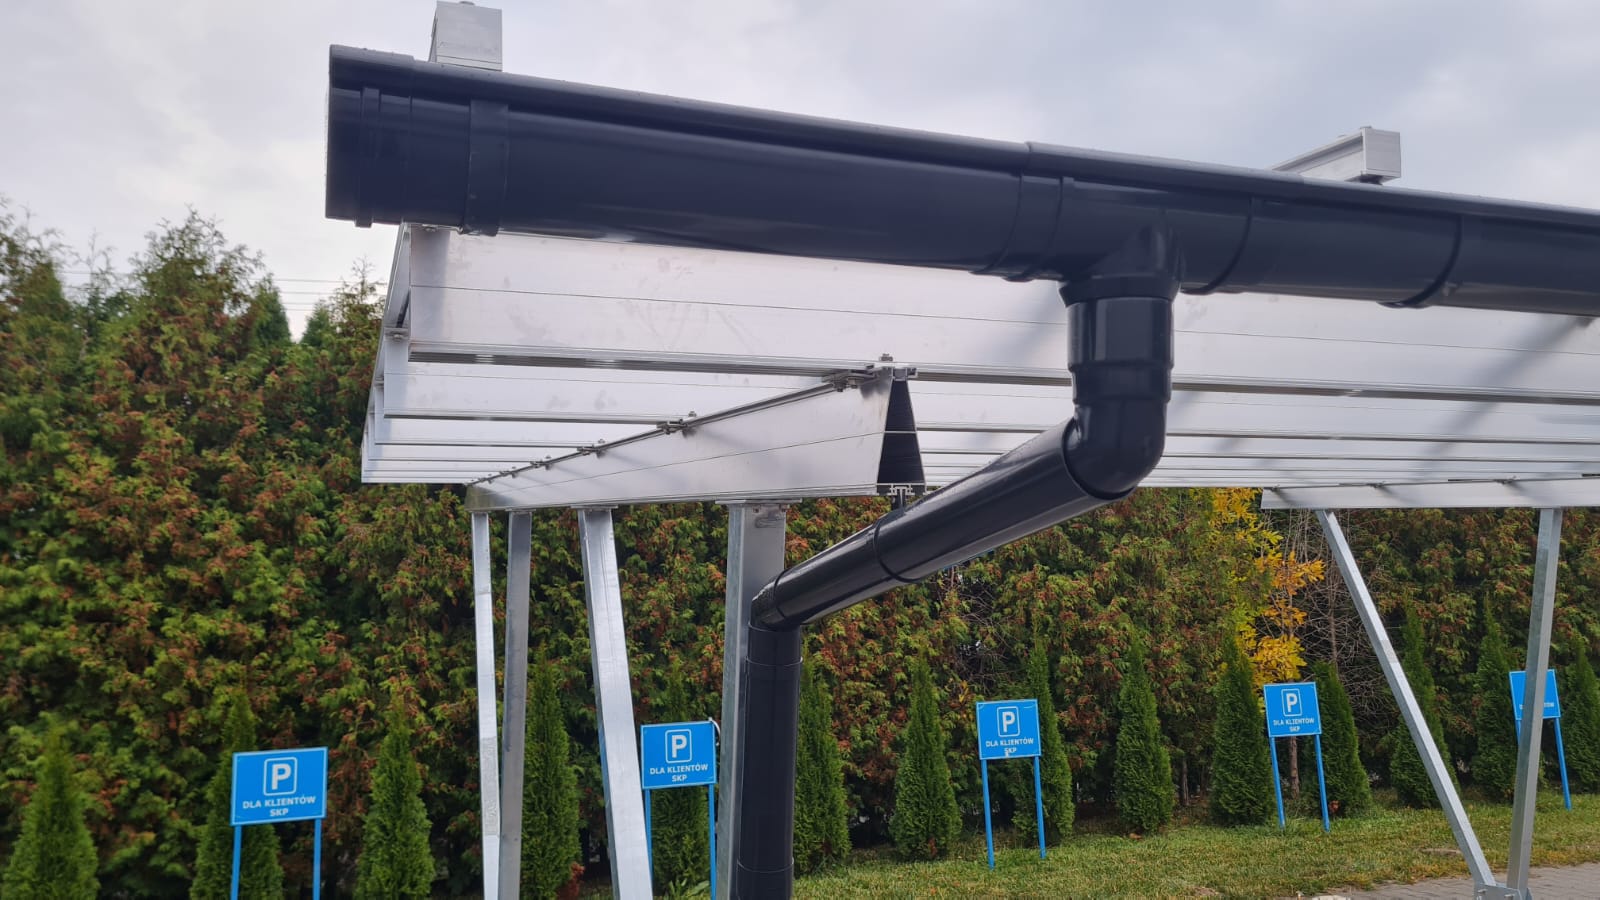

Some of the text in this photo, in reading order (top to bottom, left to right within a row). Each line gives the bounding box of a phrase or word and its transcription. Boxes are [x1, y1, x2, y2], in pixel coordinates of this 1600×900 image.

[1286, 693, 1297, 712] P
[1002, 711, 1015, 732] P
[672, 735, 687, 758] P
[272, 763, 291, 790] P
[650, 763, 708, 775] DLA KLIENTÓW
[672, 774, 687, 782] SKP
[243, 795, 316, 809] DLA KLIENTÓW
[270, 808, 288, 816] SKP
